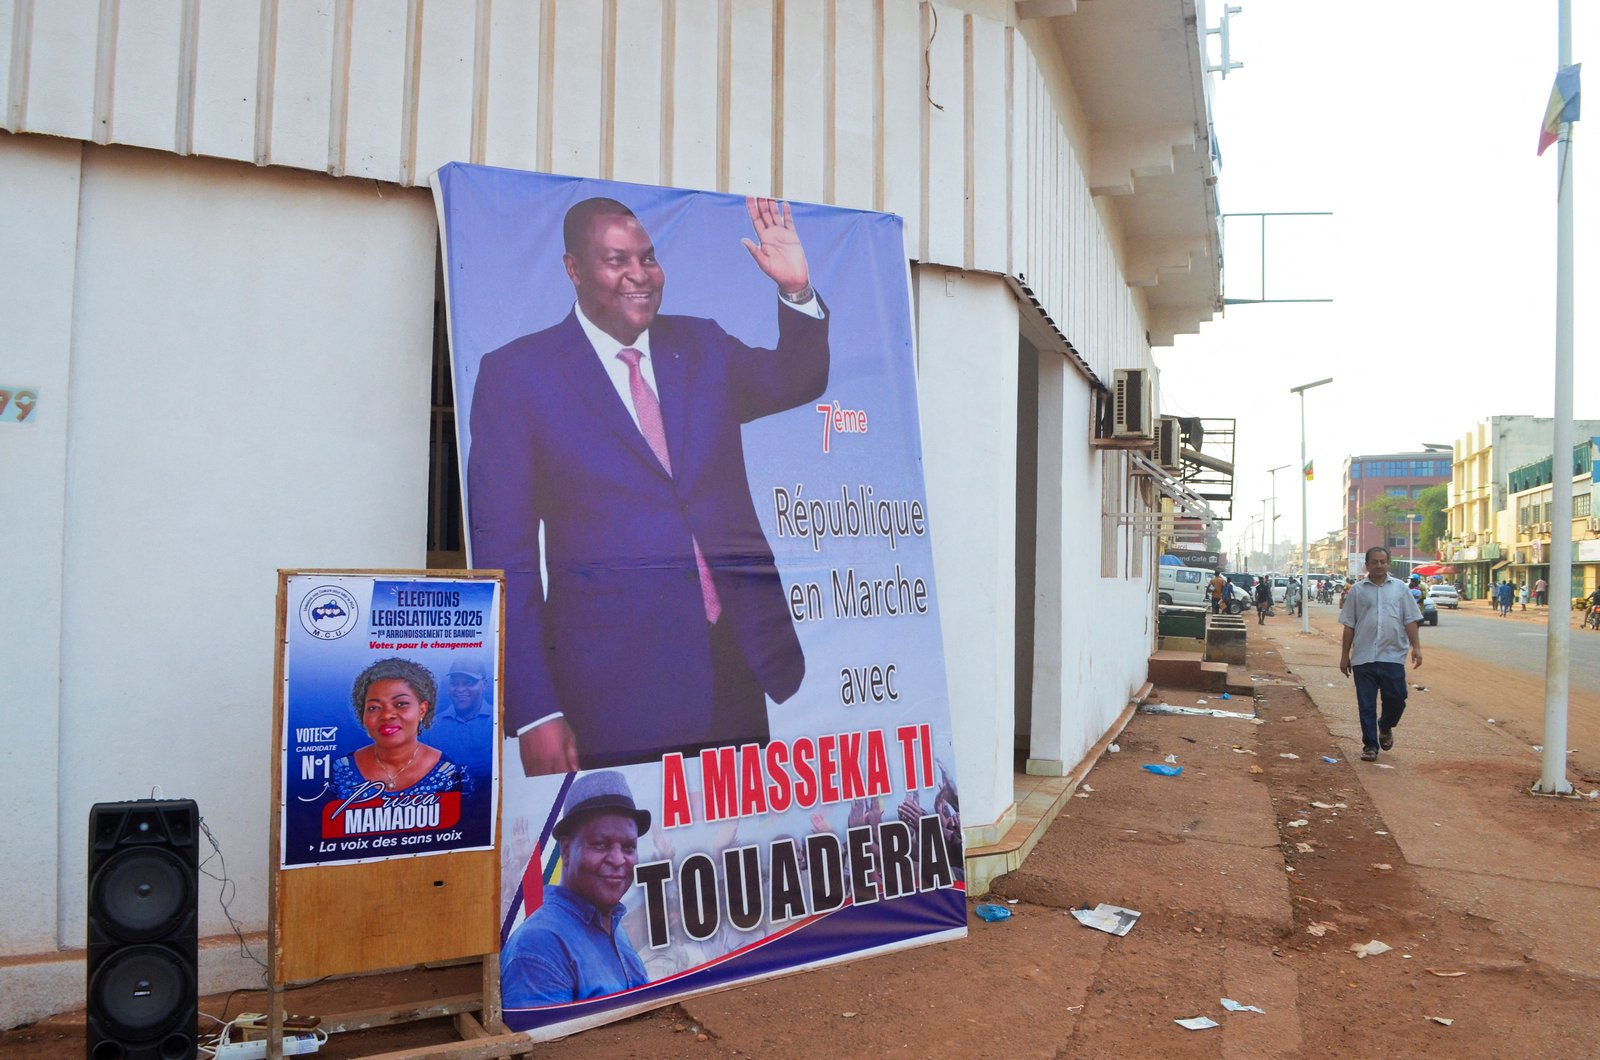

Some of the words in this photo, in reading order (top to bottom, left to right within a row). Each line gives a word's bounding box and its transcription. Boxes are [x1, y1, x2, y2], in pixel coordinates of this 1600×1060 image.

[816, 401, 867, 452] 7ème
[774, 485, 925, 550] République
[397, 590, 460, 608] ELECTIONS
[790, 583, 822, 621] en
[832, 564, 927, 617] Marche
[372, 610, 452, 627] LEGISLATIVES
[454, 610, 483, 627] 2025
[386, 629, 443, 639] ARRONDISSEMENT
[444, 629, 452, 638] DE
[453, 629, 476, 638] BANGUI
[420, 641, 429, 649] le
[430, 641, 483, 650] changement
[841, 663, 898, 704] avec
[295, 744, 337, 753] CANDIDATE
[296, 727, 320, 743] VOTE
[662, 752, 693, 829] A
[700, 728, 892, 823] MASSEKA
[896, 722, 934, 791] TI
[331, 780, 441, 820] Prisca
[344, 803, 440, 835] MAMADOU
[318, 841, 337, 853] La
[340, 838, 369, 850] voix
[372, 836, 398, 848] des
[400, 833, 432, 846] sans
[436, 829, 463, 842] voix
[634, 813, 953, 949] TOUADERA
